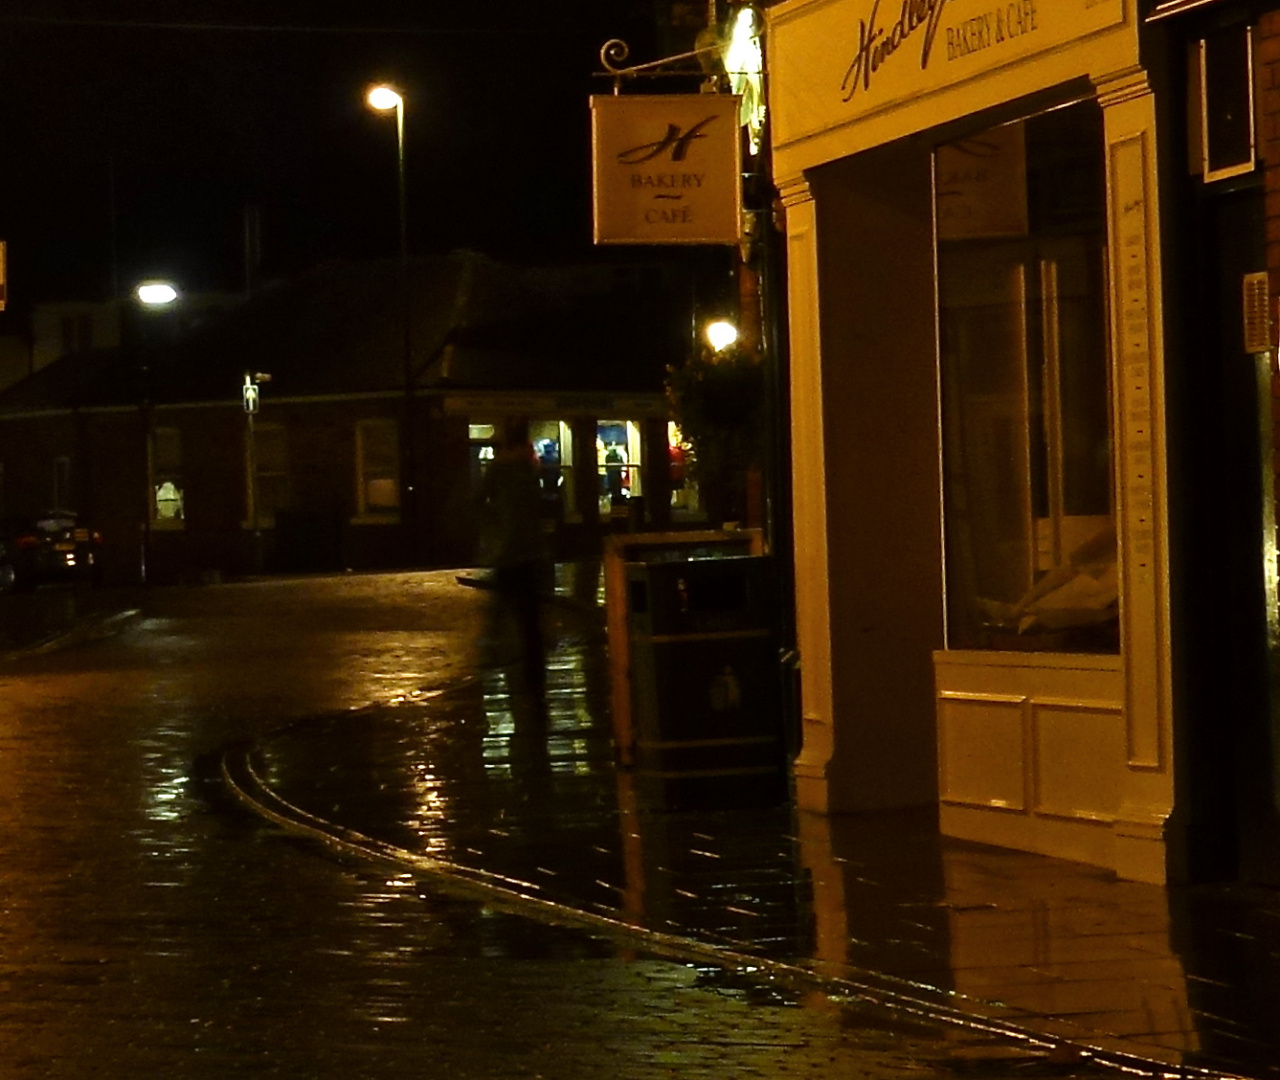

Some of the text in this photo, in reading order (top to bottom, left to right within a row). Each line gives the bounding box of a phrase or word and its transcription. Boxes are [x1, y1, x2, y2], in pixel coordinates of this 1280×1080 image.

[945, 13, 992, 62] BAKERY
[993, 6, 1005, 45] &
[630, 173, 705, 189] BAKERY
[645, 204, 692, 224] CAFÉ
